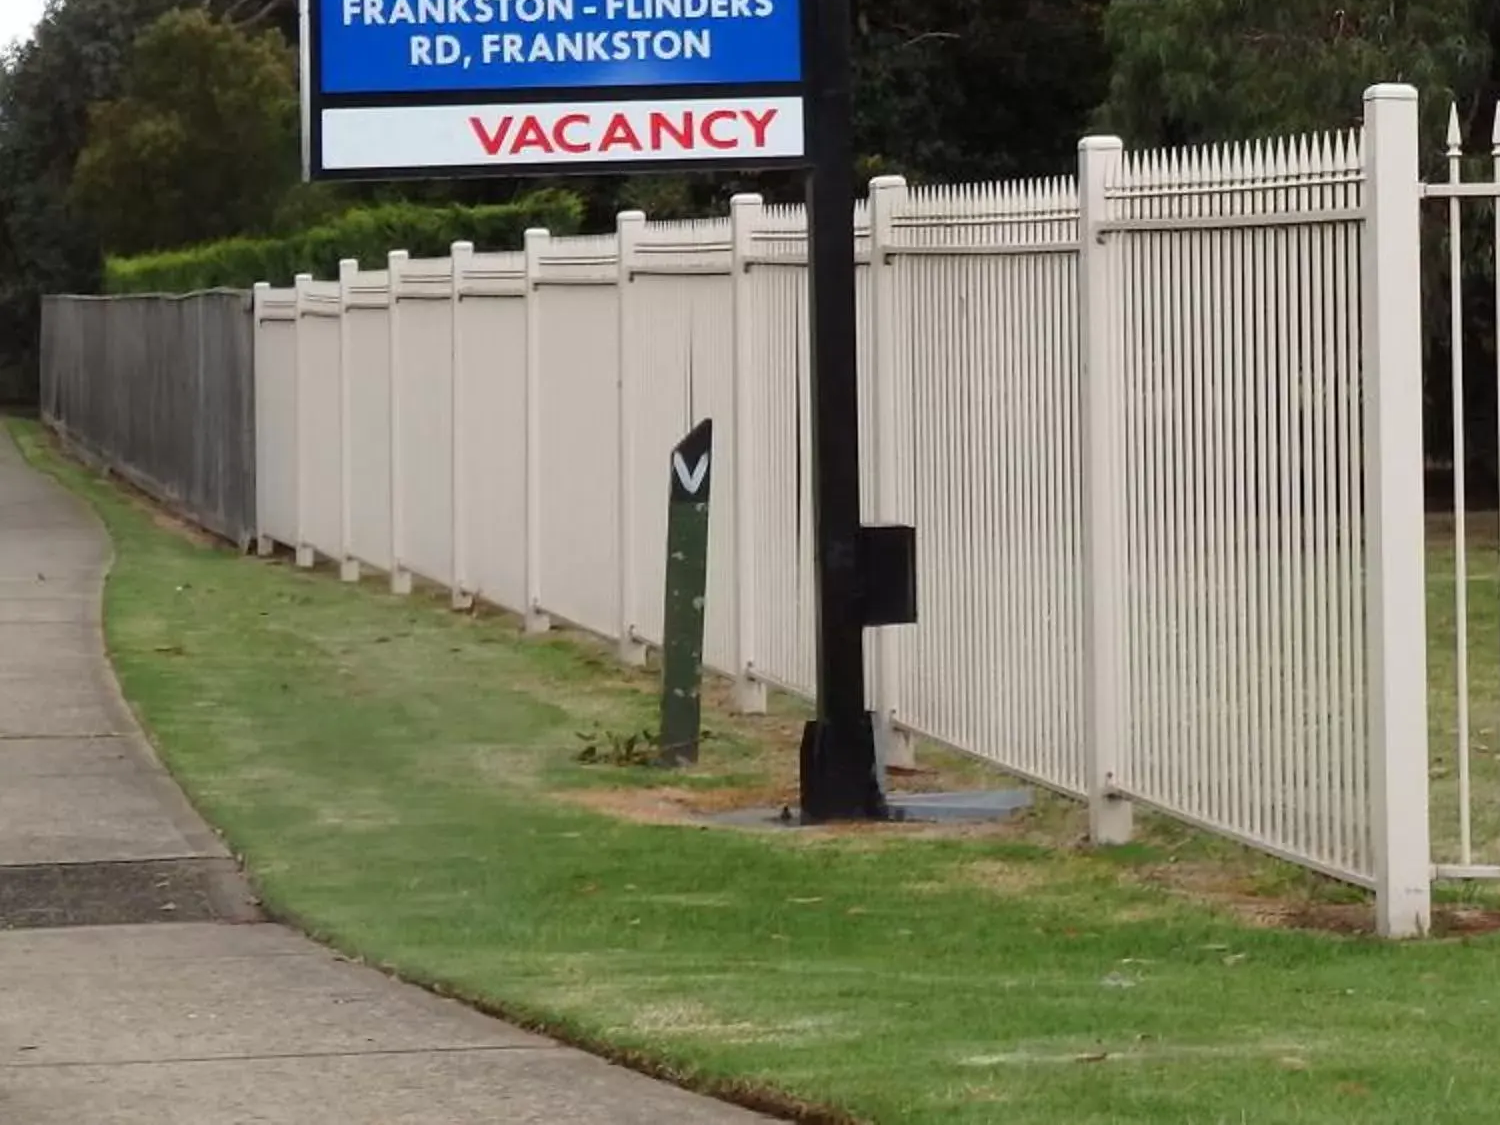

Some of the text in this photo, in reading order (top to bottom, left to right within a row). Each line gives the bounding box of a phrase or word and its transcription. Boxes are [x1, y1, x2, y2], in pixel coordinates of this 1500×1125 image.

[409, 29, 712, 70] RD, FRANKSTON
[469, 108, 779, 156] VACANCY
